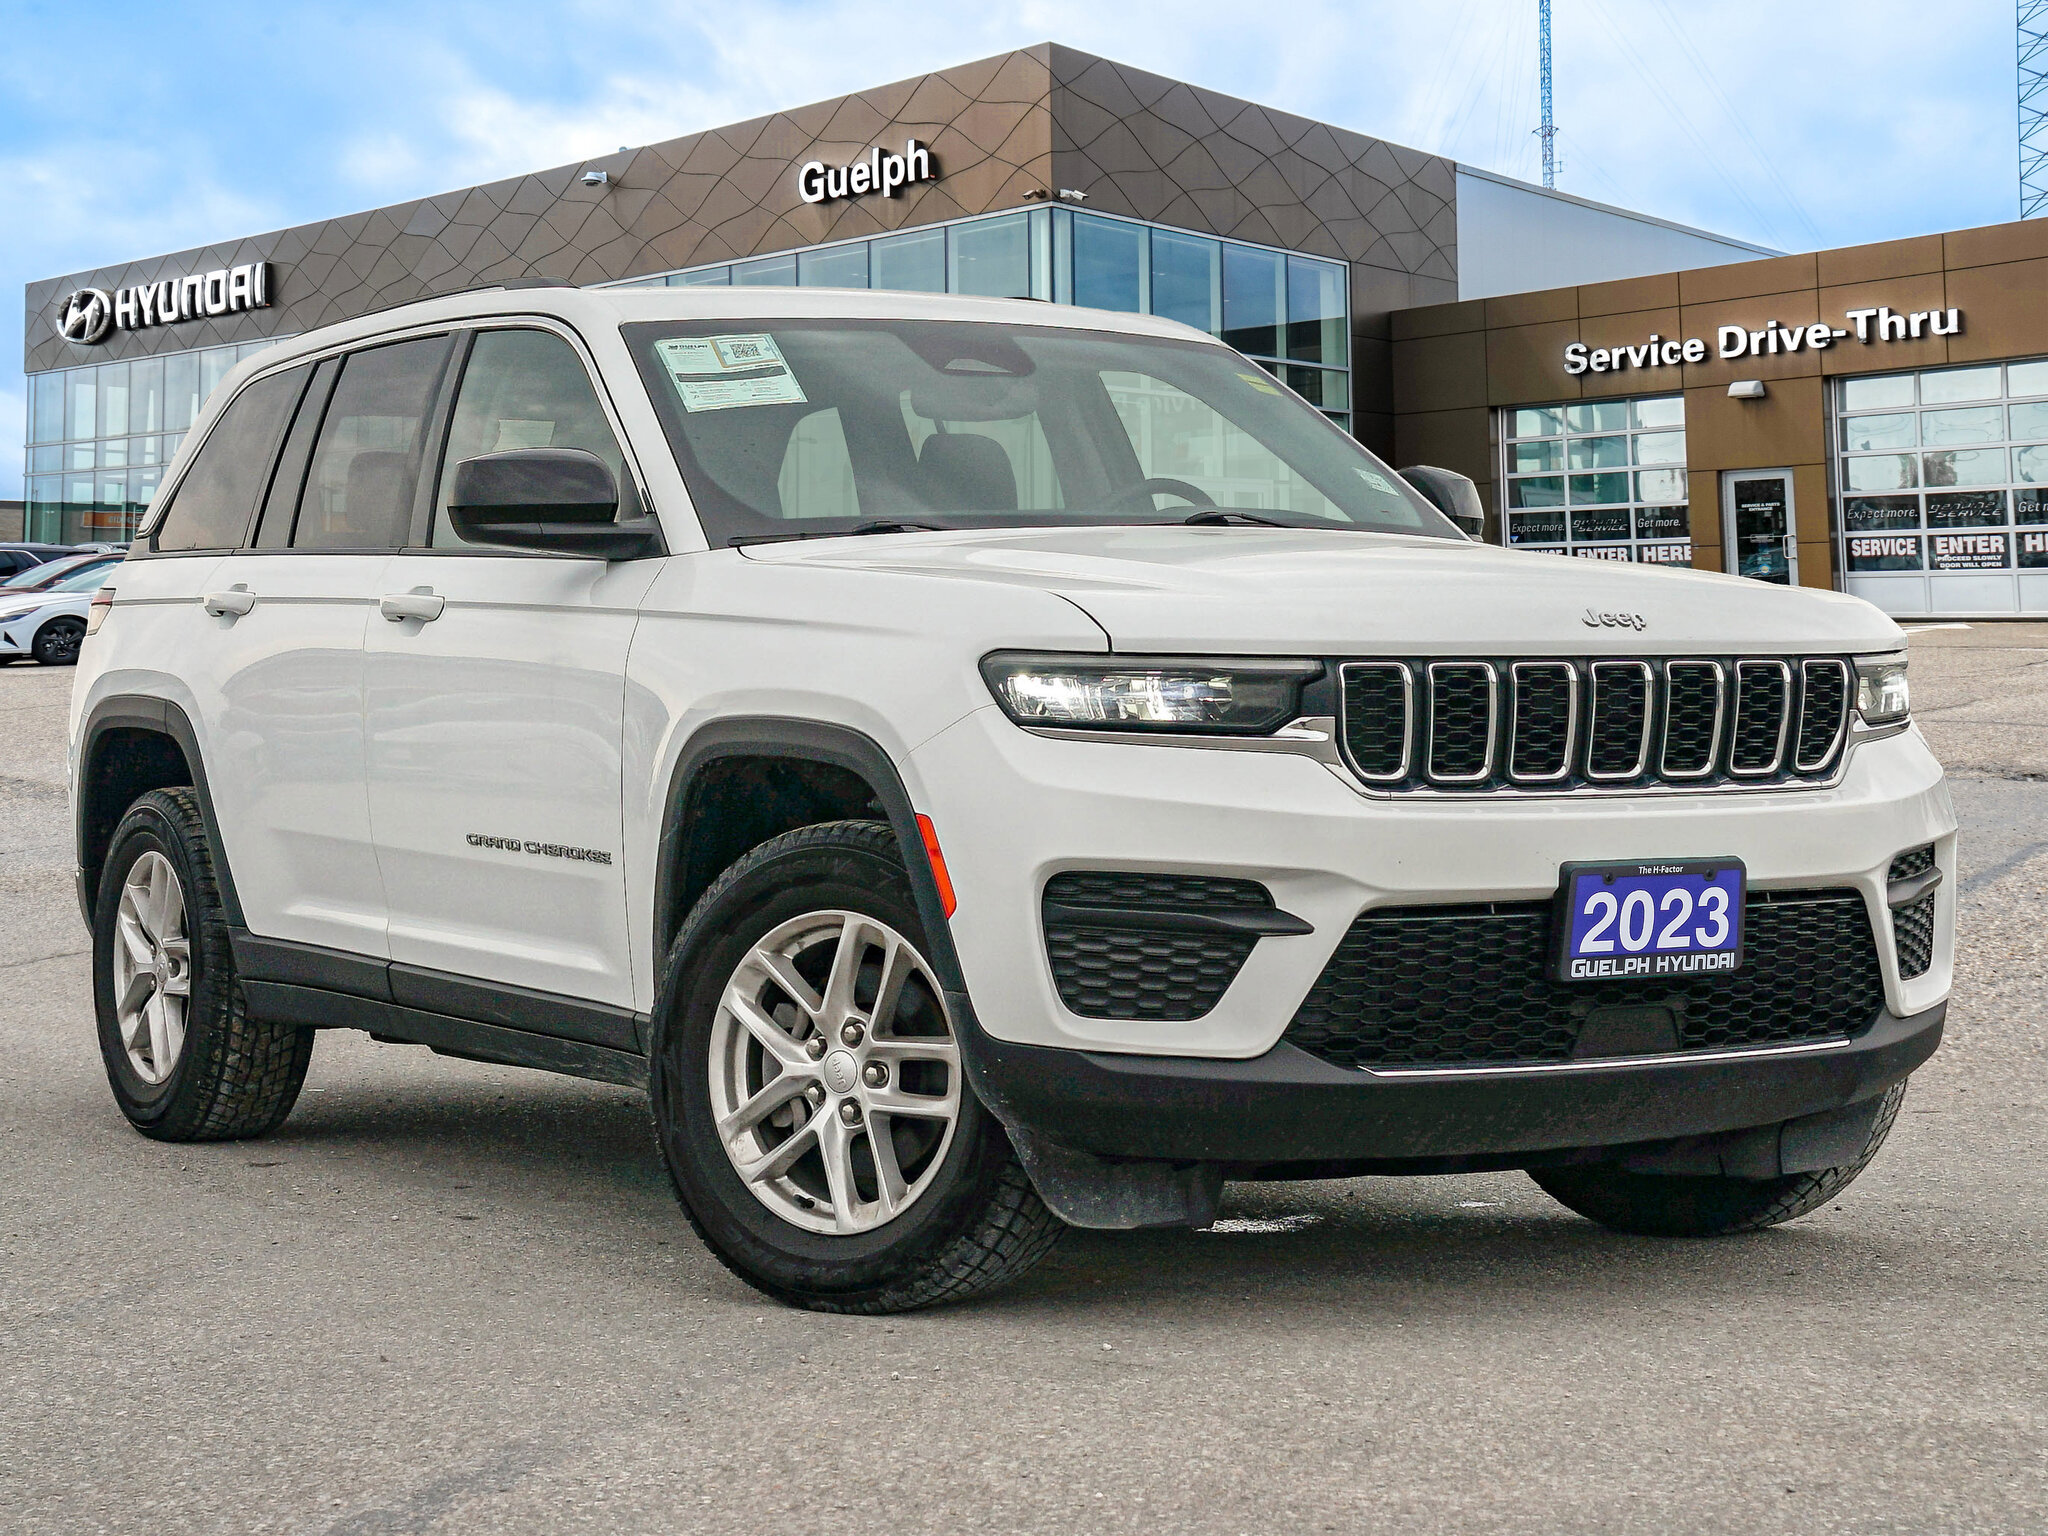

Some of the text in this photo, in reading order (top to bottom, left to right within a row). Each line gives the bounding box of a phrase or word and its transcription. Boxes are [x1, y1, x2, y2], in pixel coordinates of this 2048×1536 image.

[798, 138, 930, 204] Guelph
[114, 261, 268, 330] HYUNDAI
[1563, 306, 1961, 375] Service Drive-Thru
[1847, 508, 1918, 521] Expect more.
[1936, 508, 2002, 518] SERVICE
[2018, 501, 2040, 513] Get
[1511, 523, 1565, 533] Expect more.
[1637, 518, 1681, 528] Get more.
[1577, 547, 1629, 562] ENTER
[1851, 533, 2048, 557] SERVICE ENTER H
[1581, 608, 1647, 632] Jeep
[466, 833, 612, 865] GRAND CHEROKEE
[1639, 865, 1684, 874] The H-Factor
[1579, 886, 1730, 954] 2023
[1570, 952, 1735, 979] GUELPH HYUNDAI
